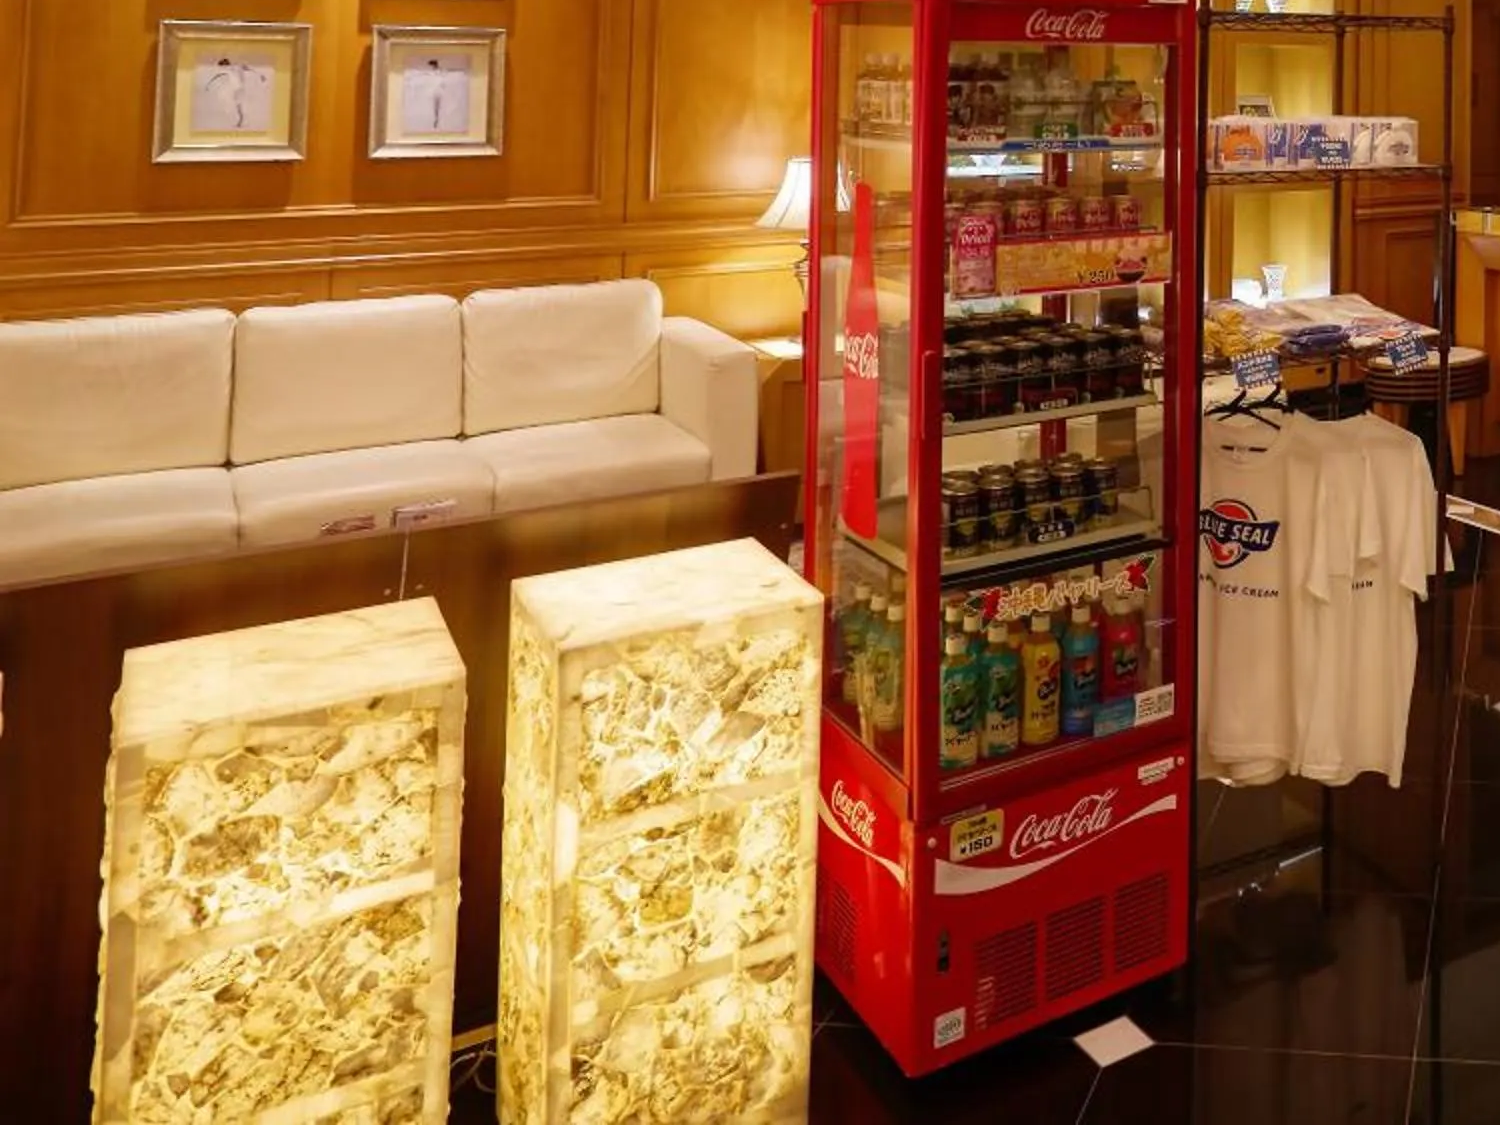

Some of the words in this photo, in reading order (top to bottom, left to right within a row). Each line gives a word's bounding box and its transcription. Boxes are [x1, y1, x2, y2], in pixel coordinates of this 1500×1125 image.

[1231, 524, 1271, 545] SEAL
[1241, 586, 1279, 598] CREAM
[1010, 789, 1119, 860] Coca-Cola
